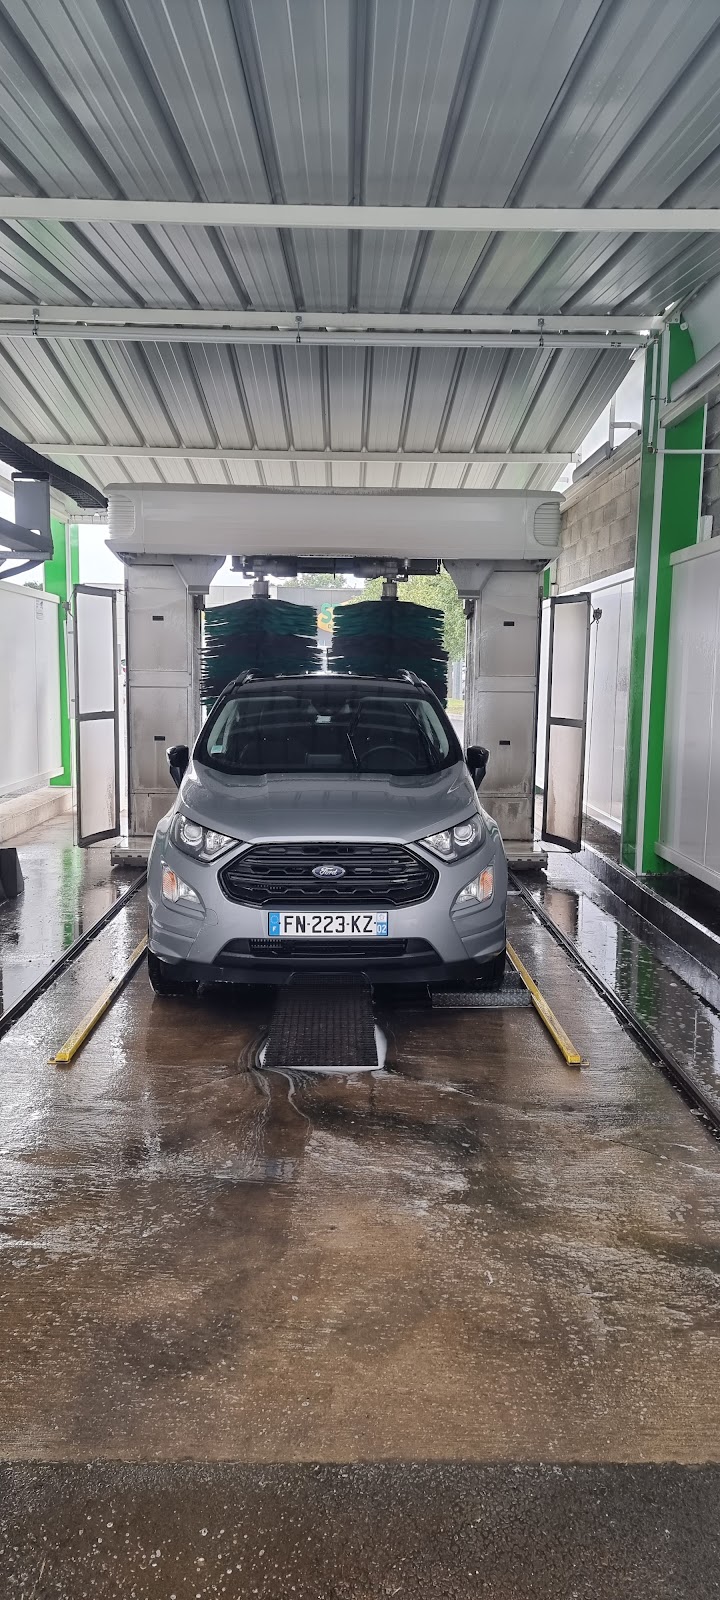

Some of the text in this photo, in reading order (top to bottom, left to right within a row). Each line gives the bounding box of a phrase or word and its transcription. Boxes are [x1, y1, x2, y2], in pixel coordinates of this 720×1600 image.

[319, 867, 338, 875] Ford
[284, 915, 373, 933] FN-223-KZ
[377, 925, 387, 933] 02
